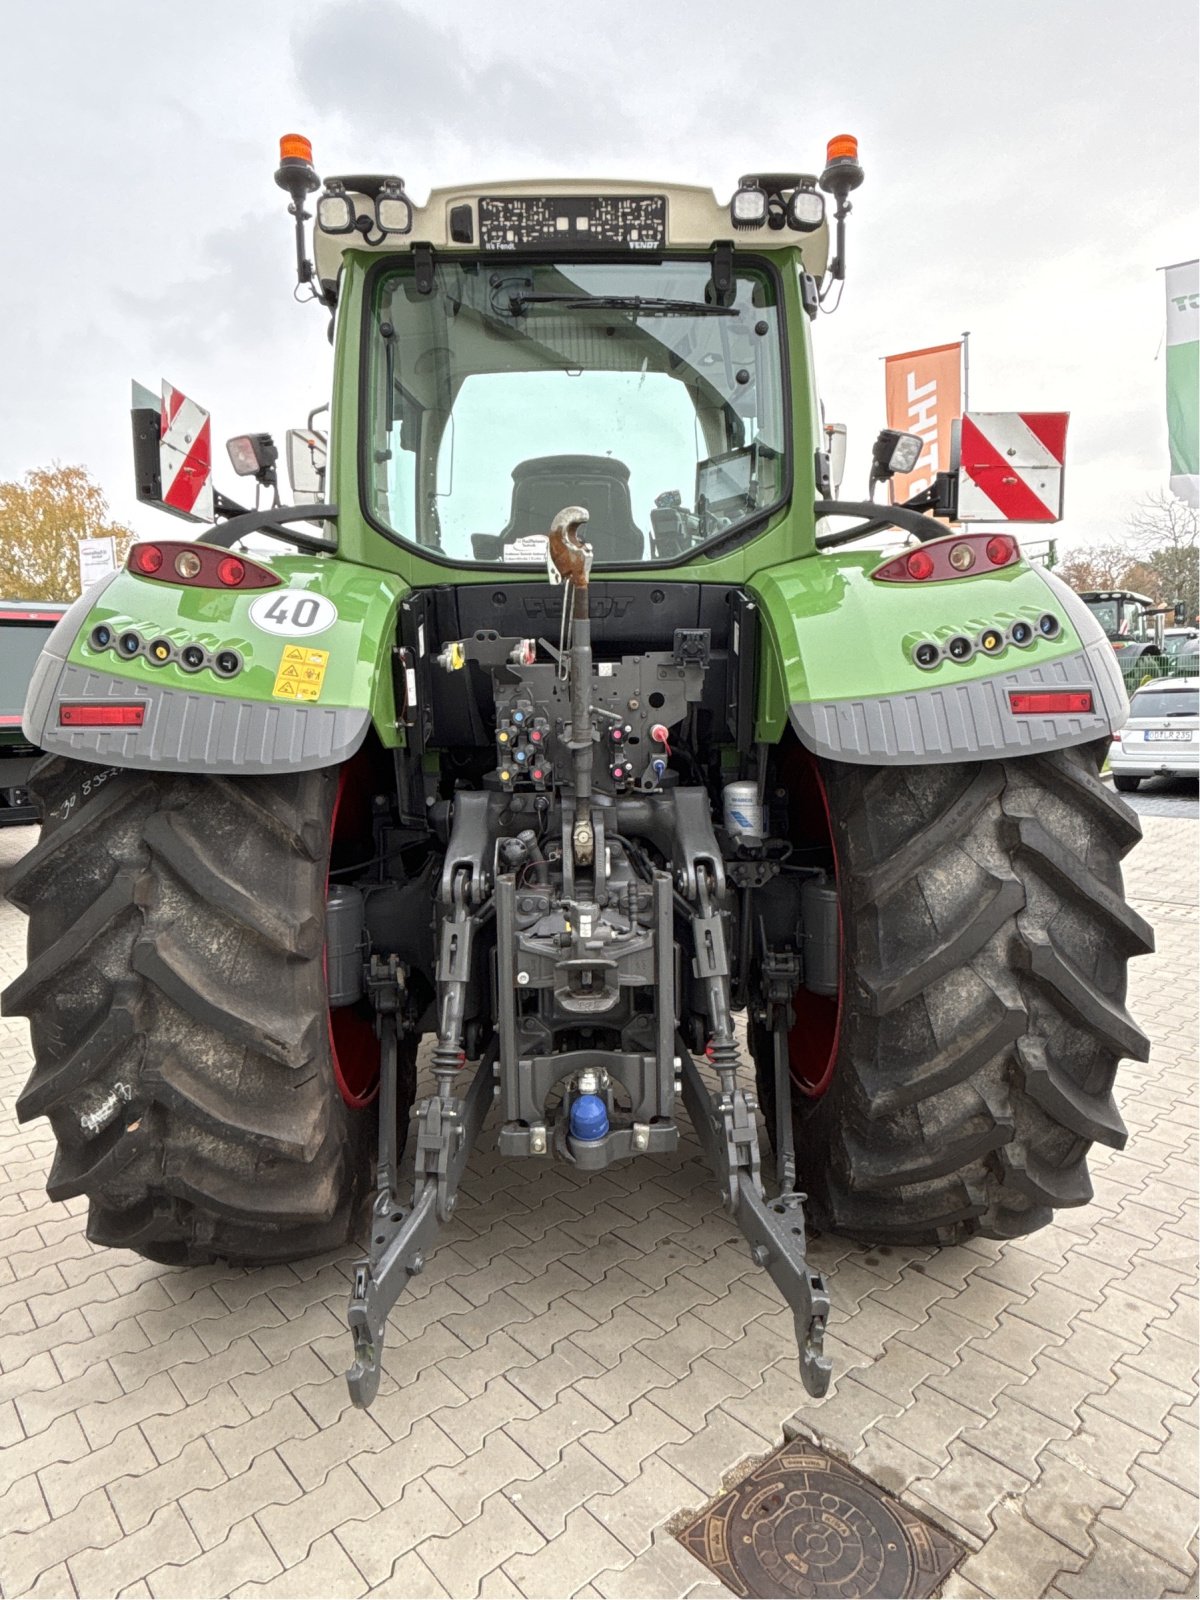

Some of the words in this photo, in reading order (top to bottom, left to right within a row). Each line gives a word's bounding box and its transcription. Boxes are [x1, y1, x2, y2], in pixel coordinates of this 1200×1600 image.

[628, 241, 660, 249] FENDT
[263, 595, 321, 628] 40
[522, 596, 636, 619] FEDT
